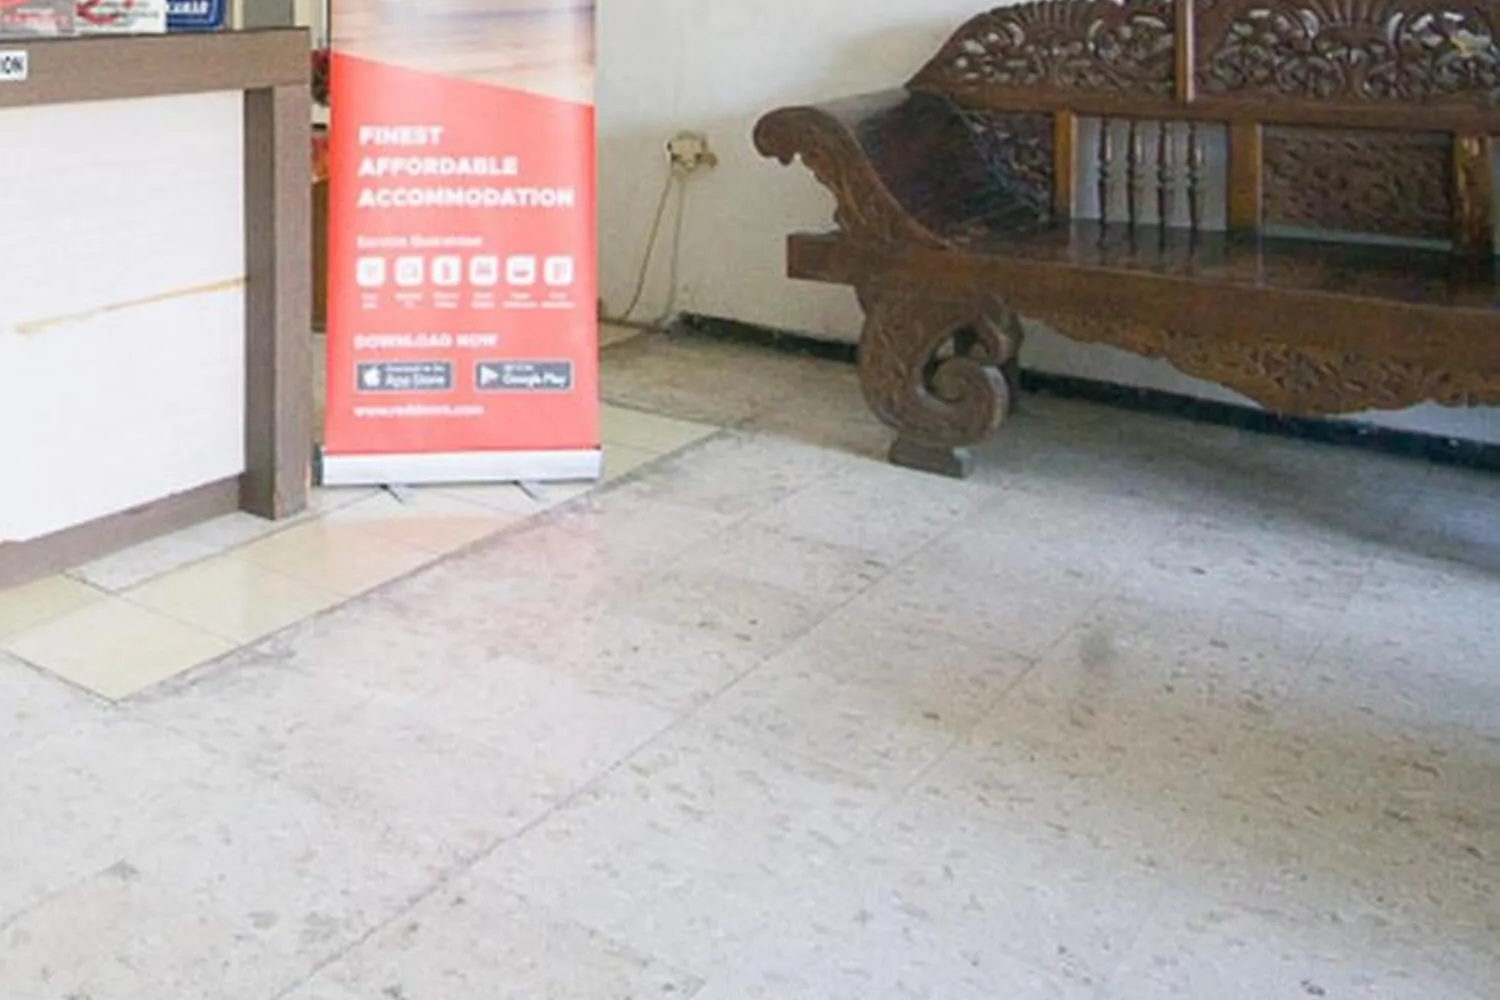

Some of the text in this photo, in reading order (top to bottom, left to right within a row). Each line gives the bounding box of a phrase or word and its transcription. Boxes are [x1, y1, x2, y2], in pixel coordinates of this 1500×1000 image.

[358, 125, 443, 146] FINEST
[357, 156, 518, 177] AFFORDABLE
[356, 187, 576, 208] ACCOMMODATION
[354, 332, 499, 349] DOWNLOAD NOW
